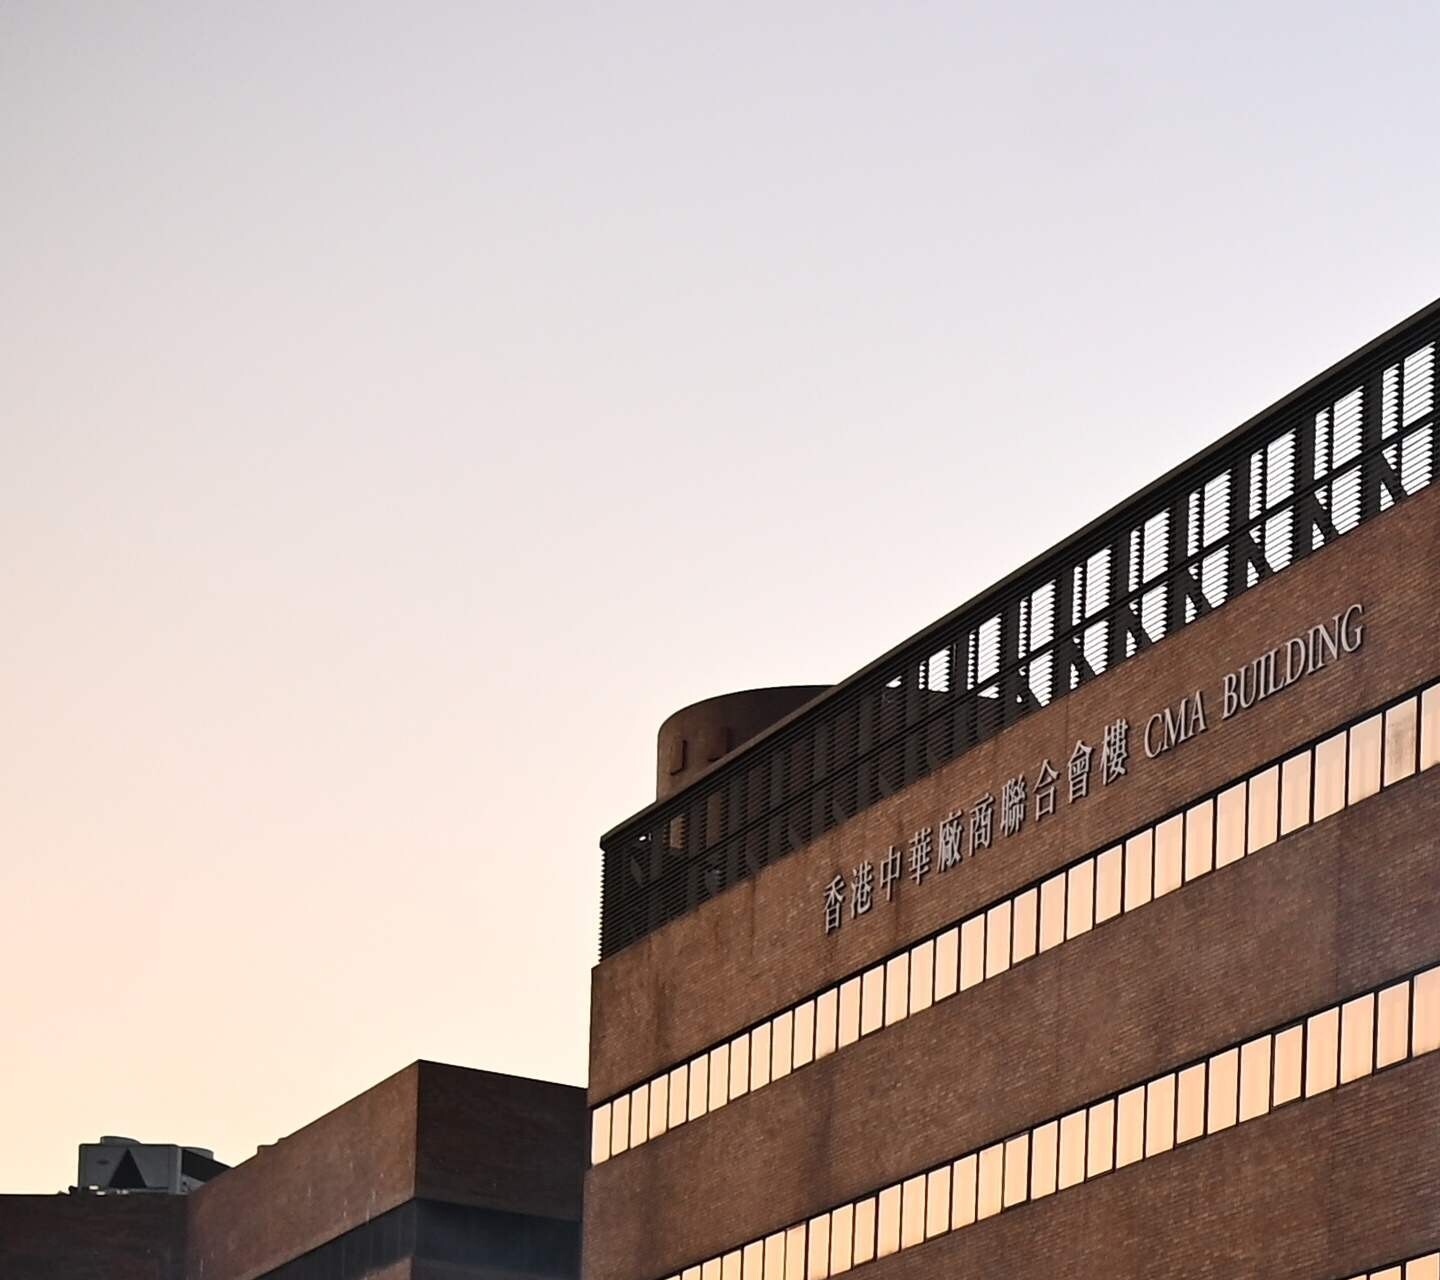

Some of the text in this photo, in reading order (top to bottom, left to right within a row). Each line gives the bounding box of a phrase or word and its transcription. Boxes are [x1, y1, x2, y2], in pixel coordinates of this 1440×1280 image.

[821, 603, 1364, 935] 香港中華廠商聯合會樓 CMA BUILDING
